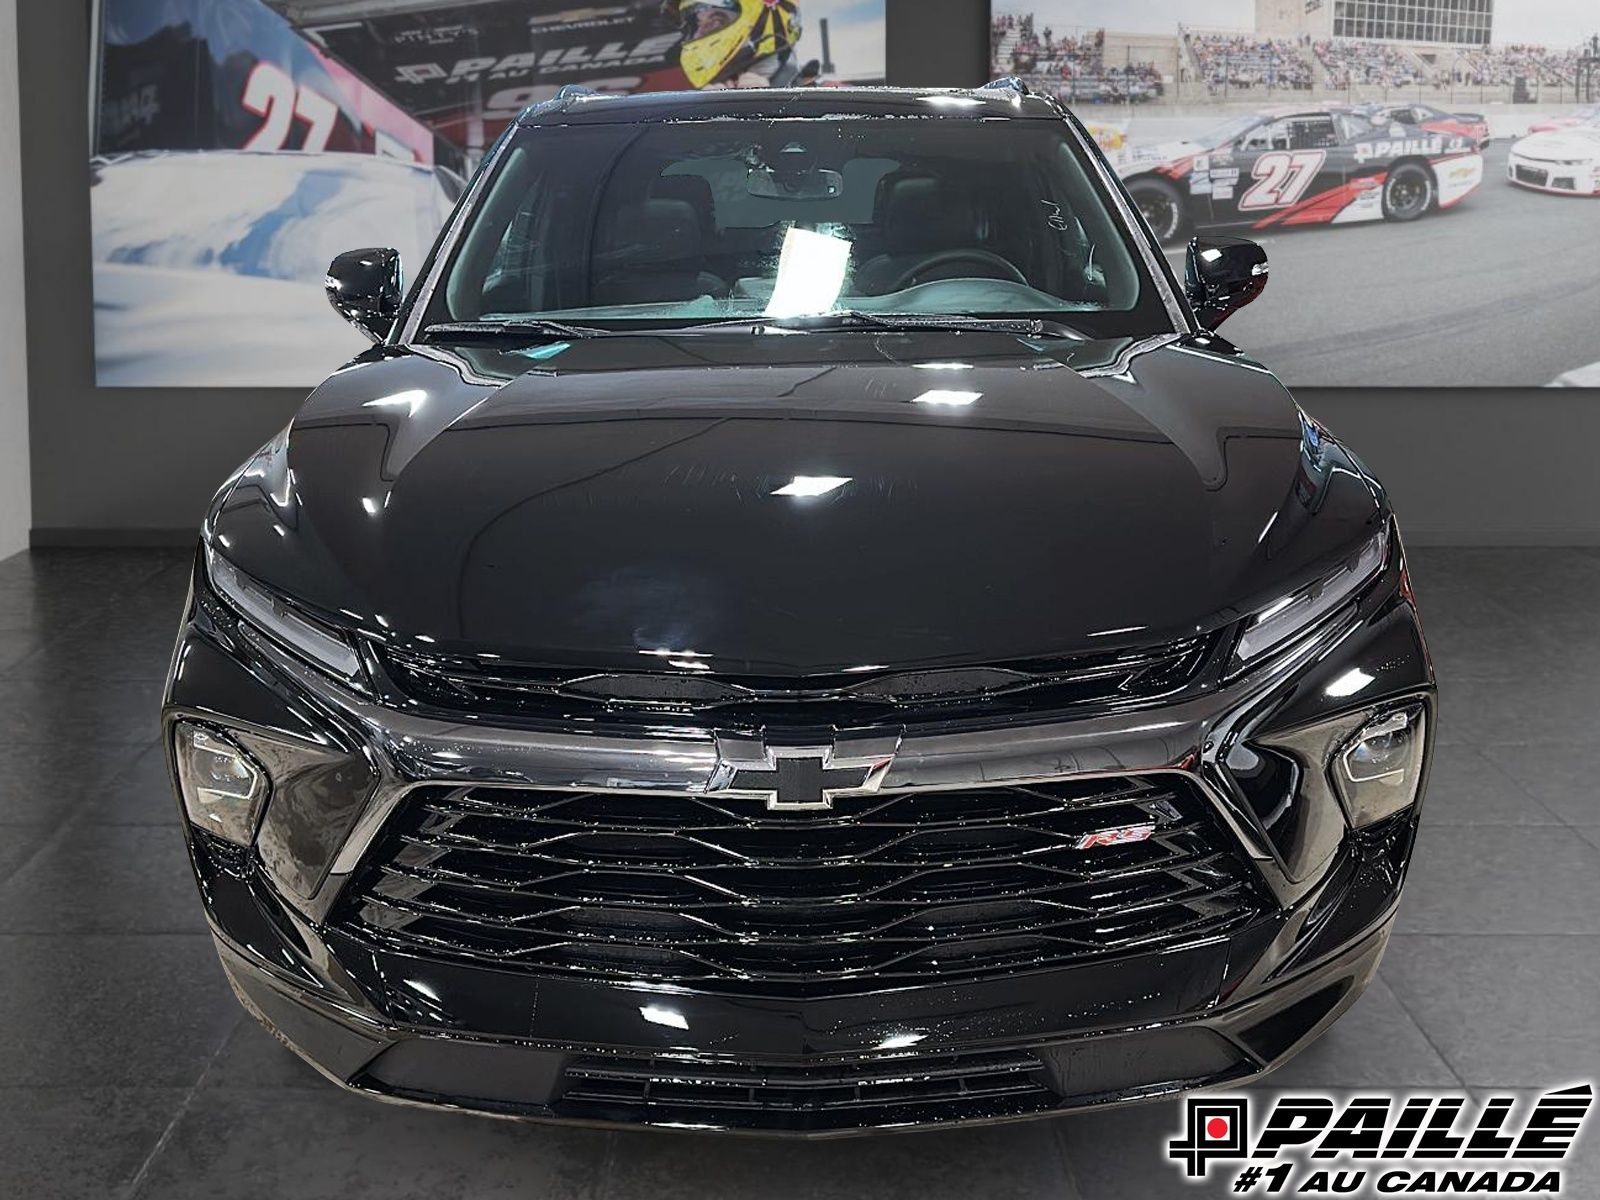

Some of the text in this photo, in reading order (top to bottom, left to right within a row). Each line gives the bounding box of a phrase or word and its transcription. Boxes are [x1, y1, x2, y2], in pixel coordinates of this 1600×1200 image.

[531, 16, 636, 34] CHEVROLET
[488, 69, 530, 80] AU
[539, 55, 665, 74] CANADA
[241, 60, 338, 153] 27
[1238, 149, 1327, 211] 27
[1075, 825, 1156, 849] RS
